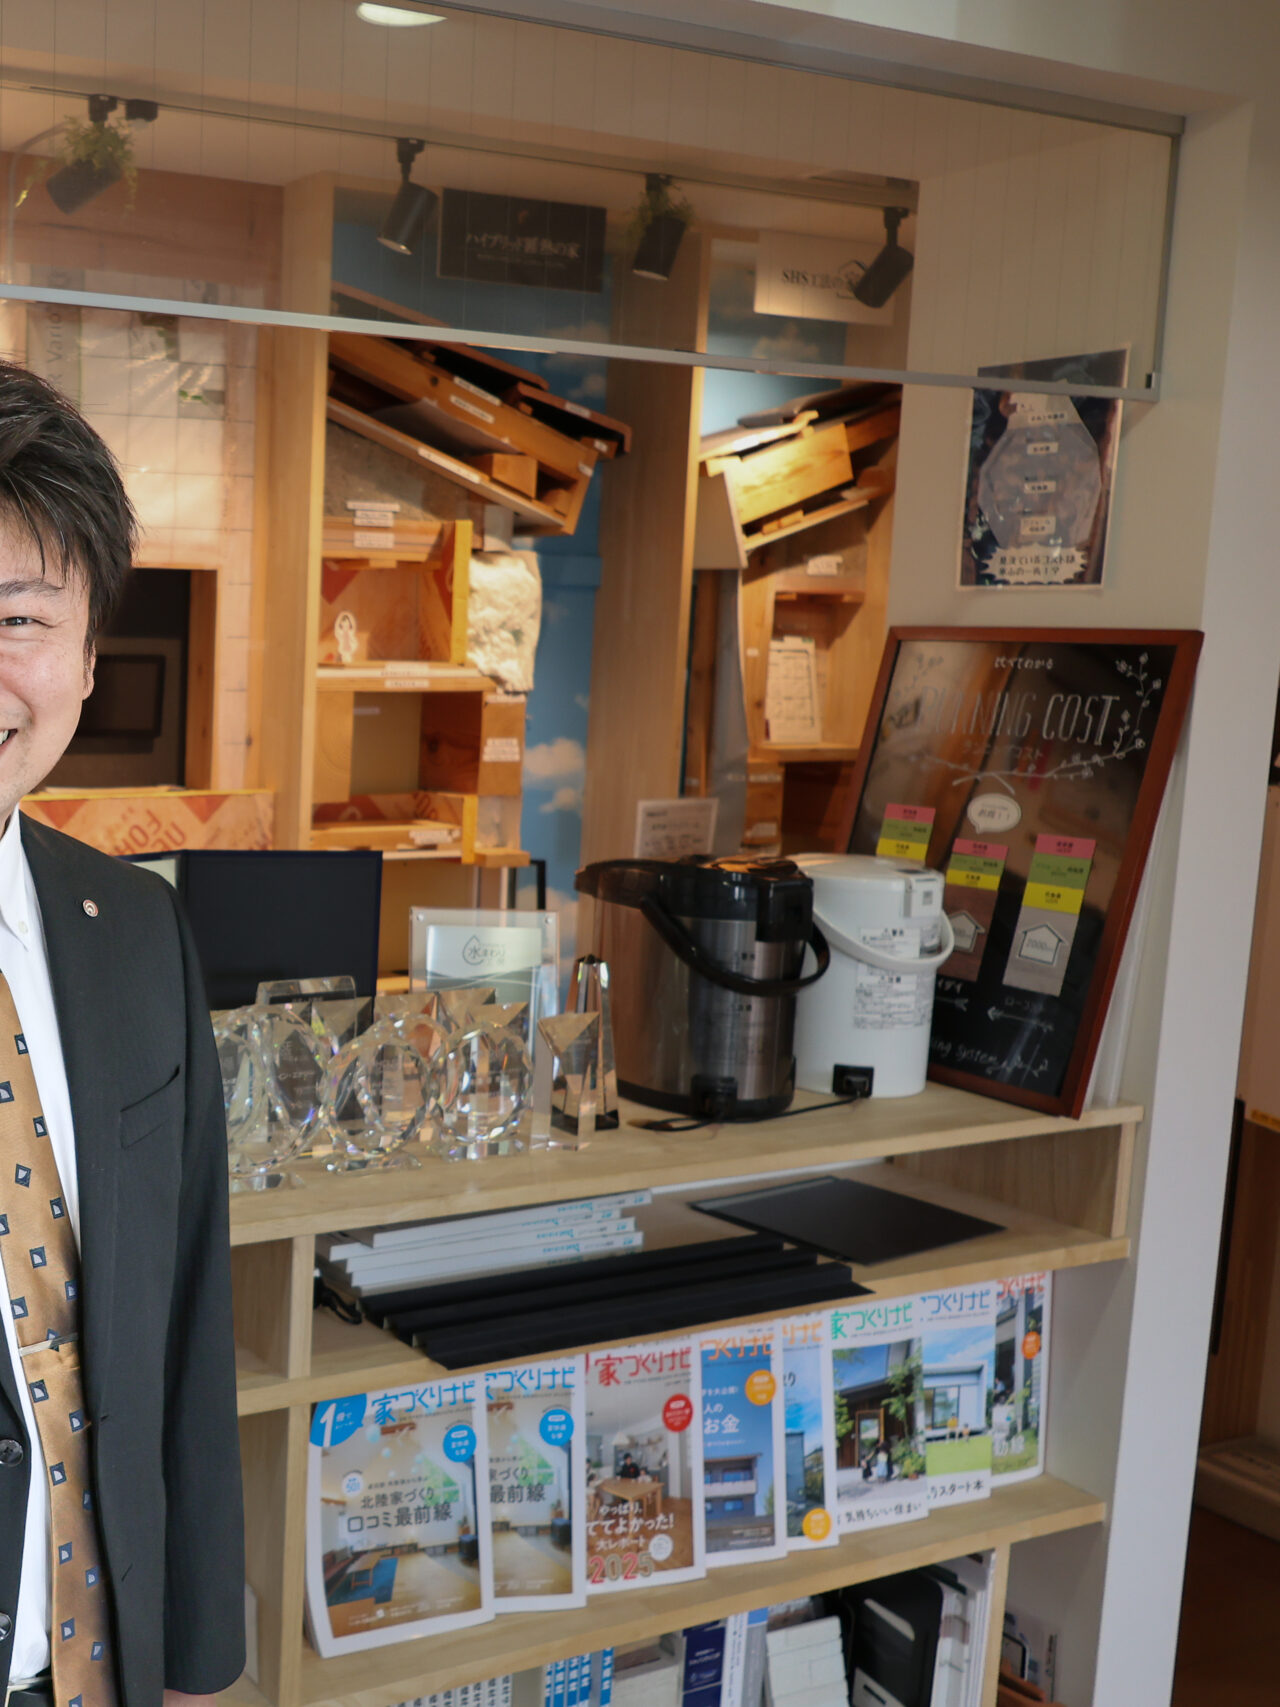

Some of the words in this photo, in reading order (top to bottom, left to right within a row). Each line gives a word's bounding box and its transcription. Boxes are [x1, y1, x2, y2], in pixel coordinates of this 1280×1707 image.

[1042, 694, 1120, 746] COST
[594, 1346, 693, 1388] 家づくりナビ
[371, 1380, 476, 1426] 家づくりナビ
[703, 1403, 724, 1415] 人の
[703, 1413, 741, 1435] お金
[361, 1486, 435, 1510] 北陸家づくり
[490, 1482, 546, 1505] 最前線
[347, 1502, 453, 1533] 口コミ最前線
[588, 1551, 655, 1585] 2025
